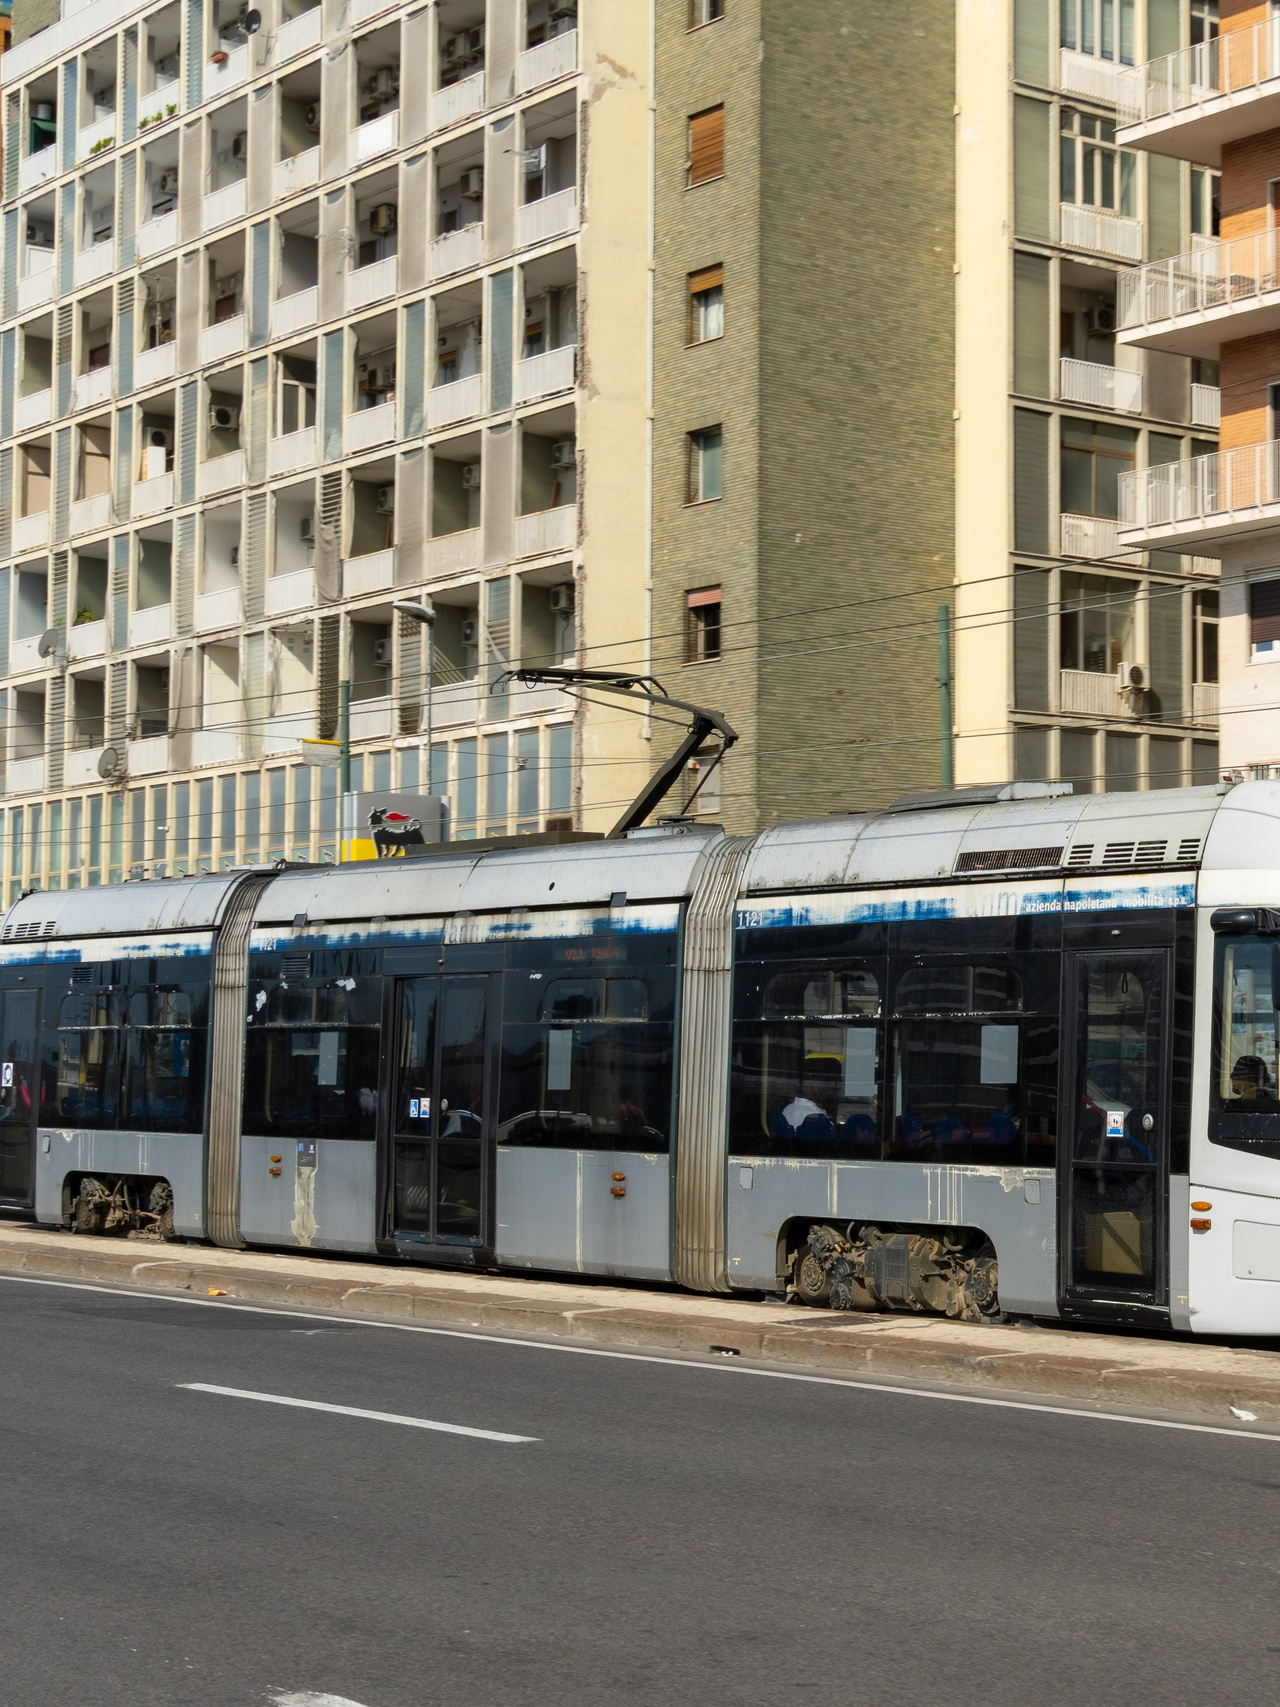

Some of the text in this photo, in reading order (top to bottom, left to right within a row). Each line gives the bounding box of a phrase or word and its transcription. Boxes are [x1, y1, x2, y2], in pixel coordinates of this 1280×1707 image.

[1025, 899, 1061, 913] azienda
[1064, 897, 1117, 913] napoletana
[737, 911, 764, 927] 1121
